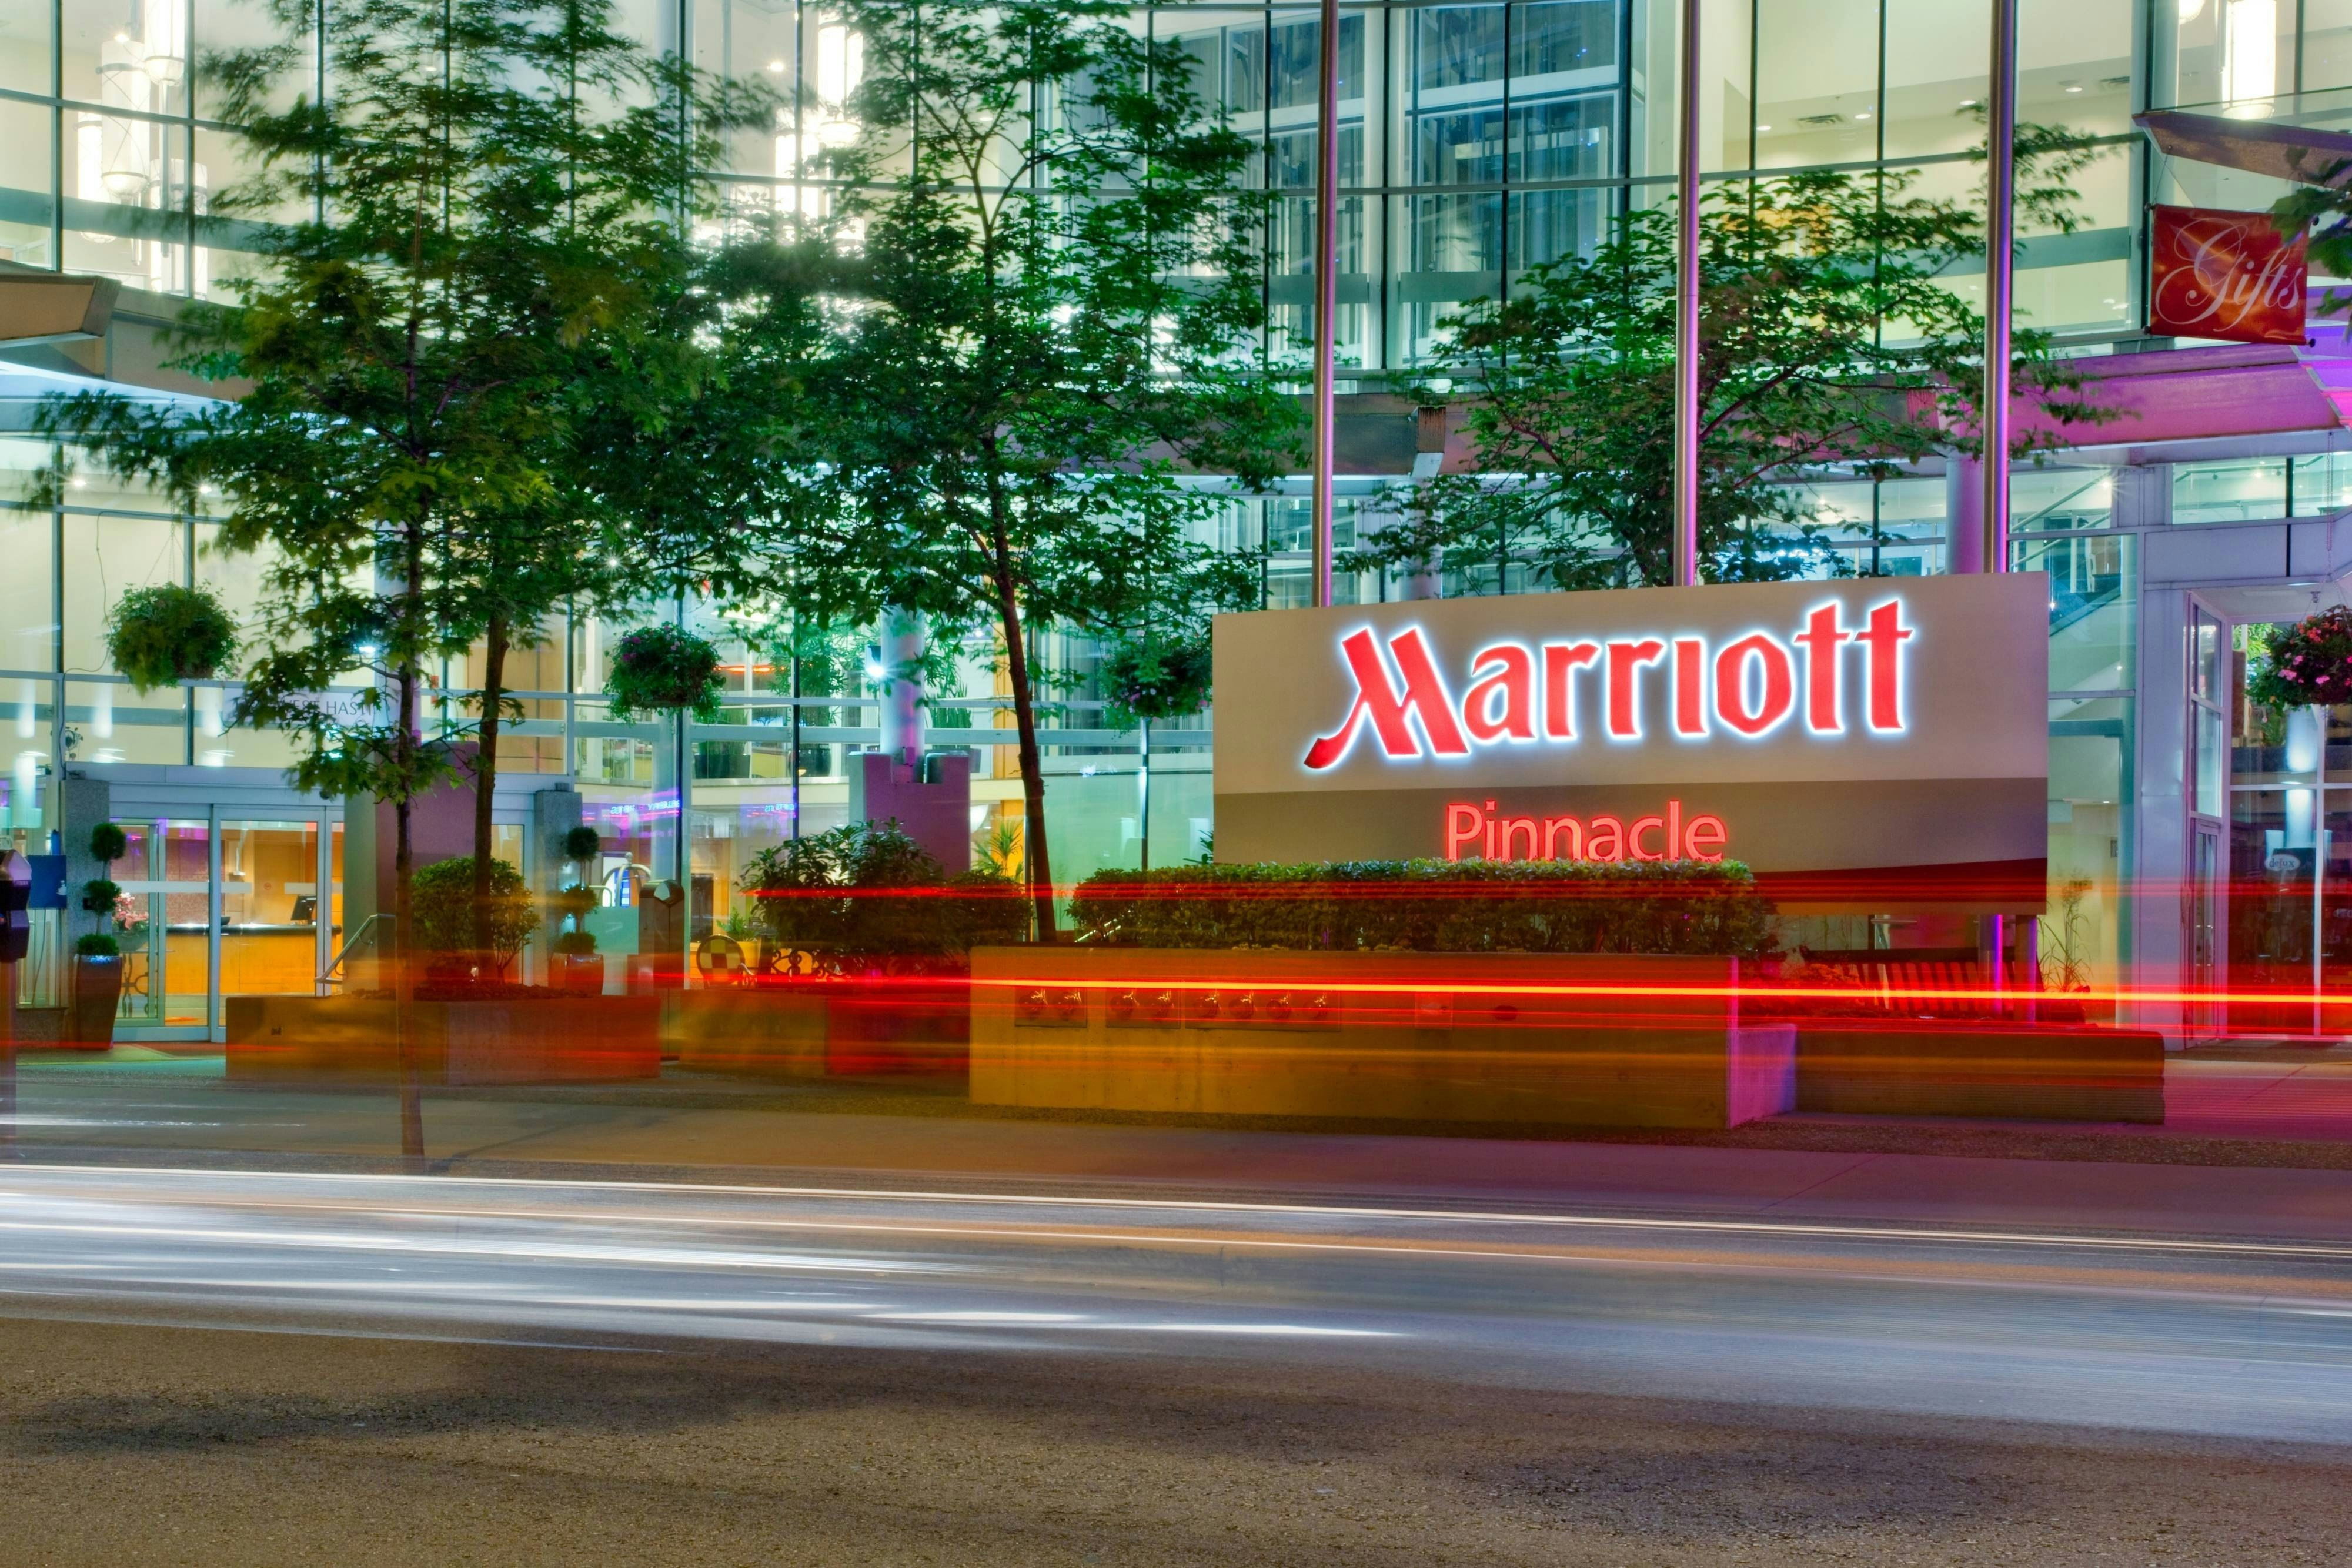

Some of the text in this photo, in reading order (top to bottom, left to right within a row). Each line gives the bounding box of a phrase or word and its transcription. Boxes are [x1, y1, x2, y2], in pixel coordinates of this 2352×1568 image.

[2155, 217, 2303, 332] Gifts
[1303, 599, 1913, 770] Marriott
[1446, 799, 1728, 862] Pinnacle
[2269, 858, 2295, 868] delux
